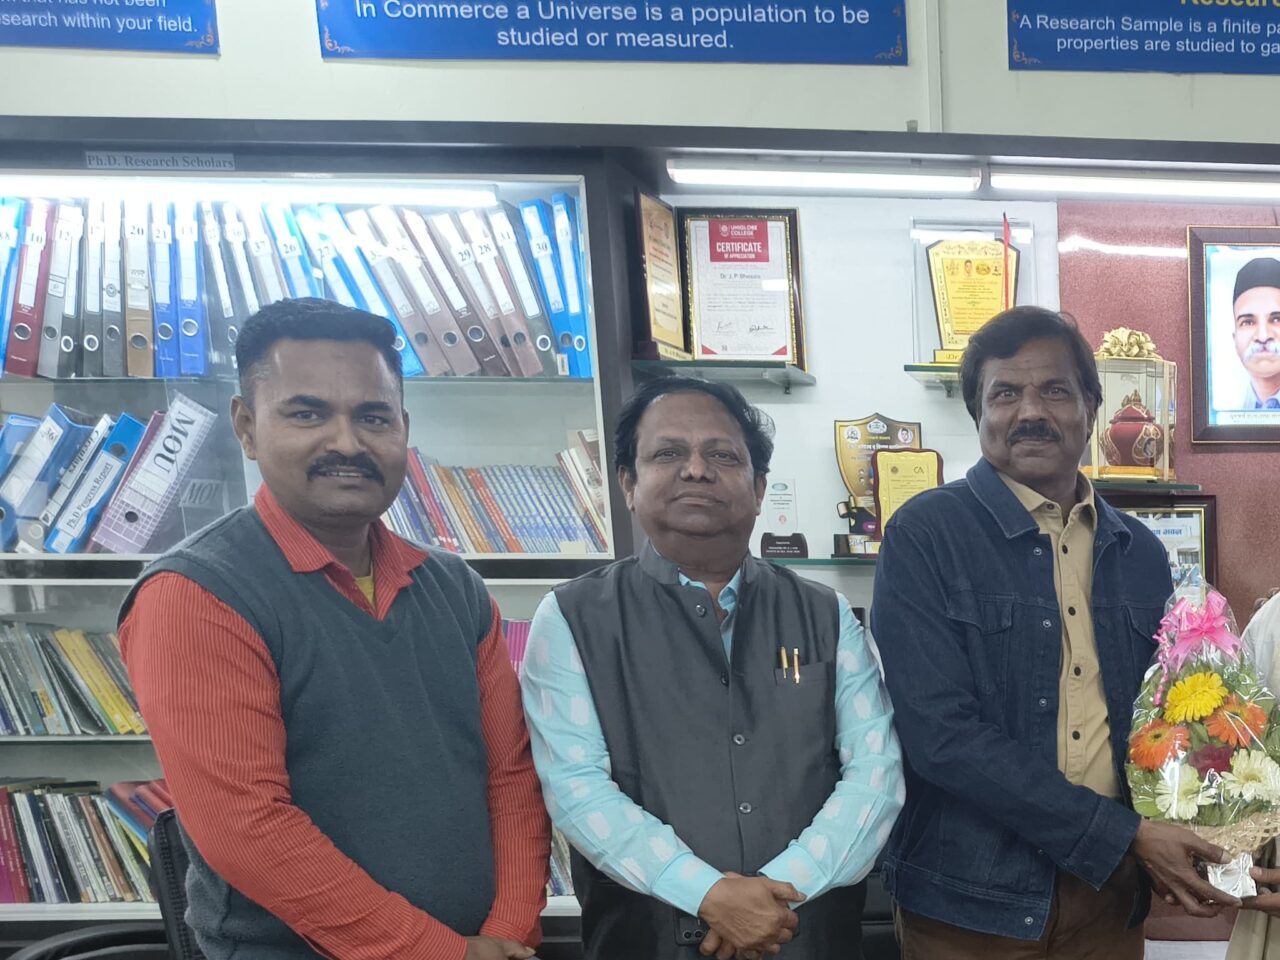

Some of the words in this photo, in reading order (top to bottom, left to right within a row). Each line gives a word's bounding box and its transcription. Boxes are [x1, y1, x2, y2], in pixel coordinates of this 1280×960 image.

[356, 0, 375, 17] In
[384, 0, 508, 18] Commerce
[517, 5, 529, 19] a
[538, 1, 636, 20] Universe
[646, 2, 662, 20] is
[671, 7, 683, 21] a
[692, 4, 806, 26] population
[815, 6, 835, 23] to
[843, 5, 869, 23] be
[62, 12, 110, 28] within
[116, 17, 152, 33] your
[157, 15, 197, 32] field.
[1020, 15, 1031, 28] A
[1037, 15, 1115, 30] Research
[1121, 16, 1183, 34] Sample
[1189, 18, 1201, 32] is
[1208, 22, 1216, 32] a
[1223, 19, 1260, 33] finite
[498, 28, 578, 46] studied
[587, 33, 608, 46] or
[616, 30, 733, 47] measured.
[1057, 36, 1138, 52] properties
[1145, 40, 1170, 51] are
[1176, 38, 1234, 52] studied
[1241, 40, 1255, 53] to
[87, 155, 120, 166] Ph.D.
[125, 155, 179, 167] Research
[182, 156, 233, 168] Scholars
[130, 226, 144, 236] 20
[283, 243, 297, 254] 26
[458, 249, 472, 261] 29
[478, 245, 492, 256] 28
[536, 243, 548, 254] 30
[716, 242, 762, 252] CERTIFICATE
[154, 410, 196, 474] MOU
[69, 430, 100, 474] Circulars
[77, 482, 98, 514] Progress
[94, 461, 113, 486] Report
